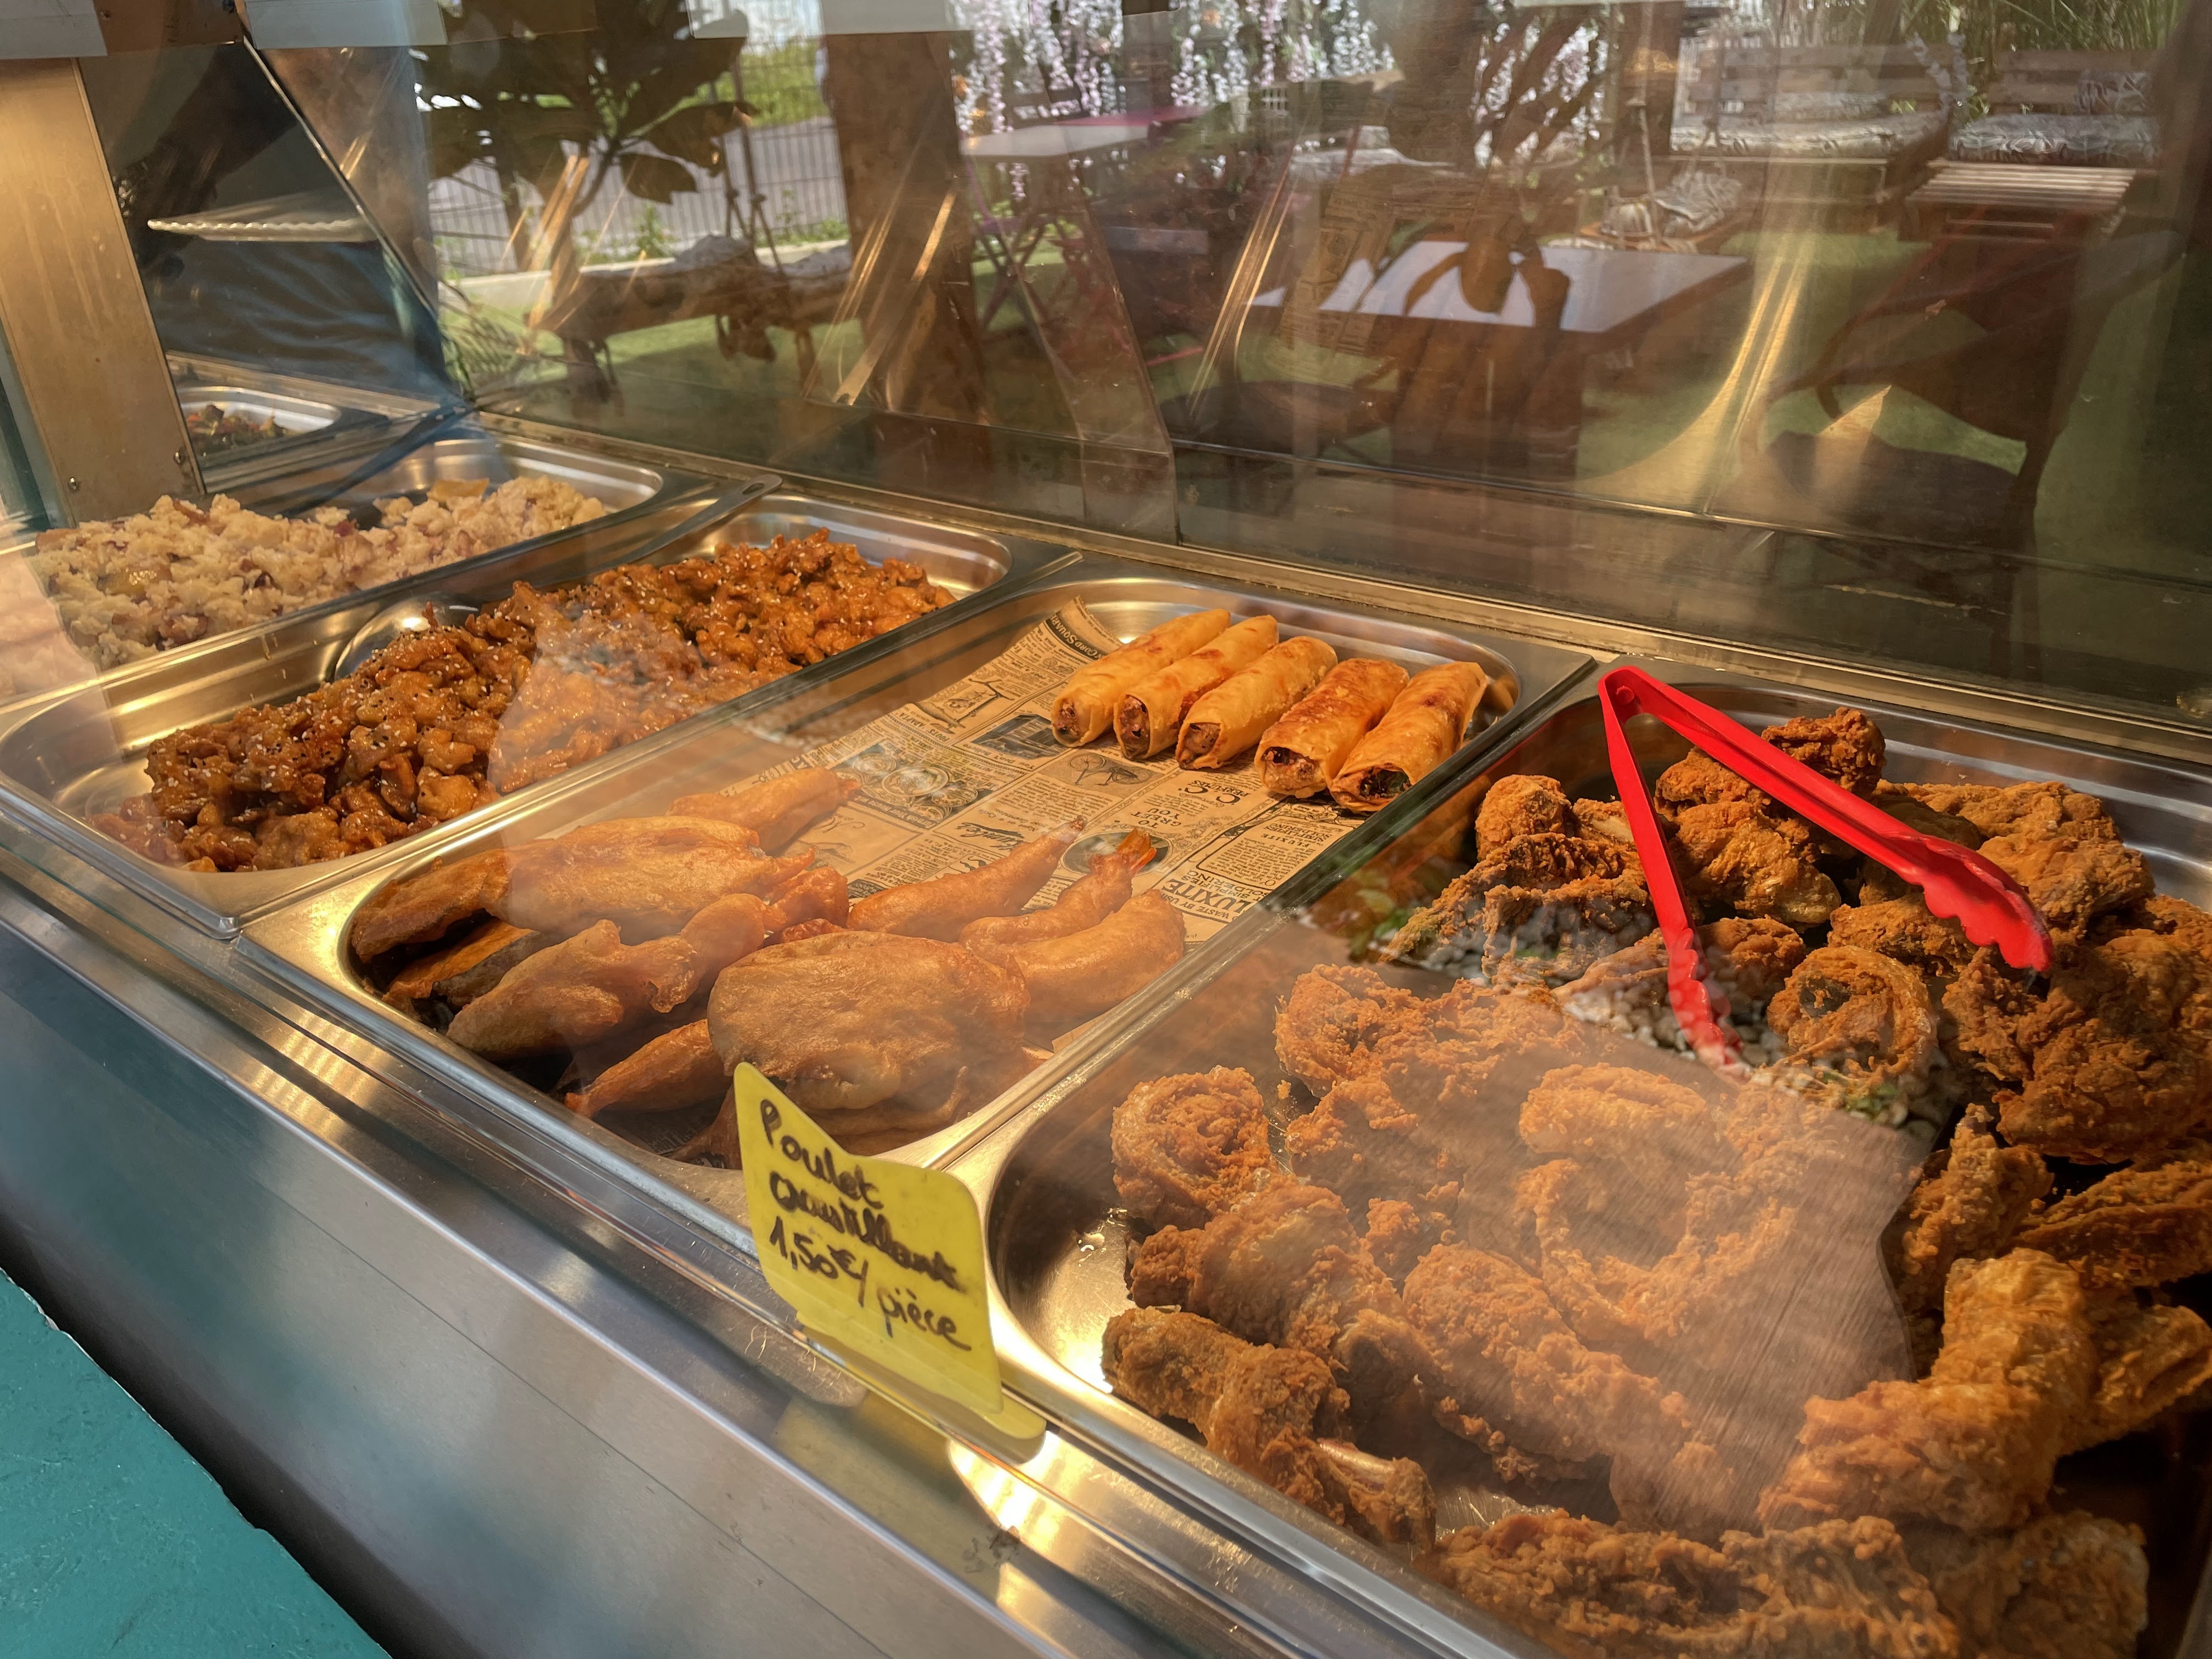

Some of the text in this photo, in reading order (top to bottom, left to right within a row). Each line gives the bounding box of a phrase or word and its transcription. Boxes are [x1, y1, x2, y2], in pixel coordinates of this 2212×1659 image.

[1191, 780, 1250, 796] PERFUMES
[1130, 811, 1182, 826] GREET
[1146, 808, 1179, 819] YOU
[1138, 820, 1159, 828] TO
[1260, 833, 1310, 847] FLUXITE
[1180, 875, 1250, 898] SIMPLIFIES
[1185, 870, 1269, 896] SOLDERING
[1161, 878, 1251, 913] LUXITE
[1179, 901, 1196, 909] BY
[1195, 906, 1229, 918] WASTE
[760, 1098, 883, 1209] Poulet
[877, 1288, 972, 1351] pièce
